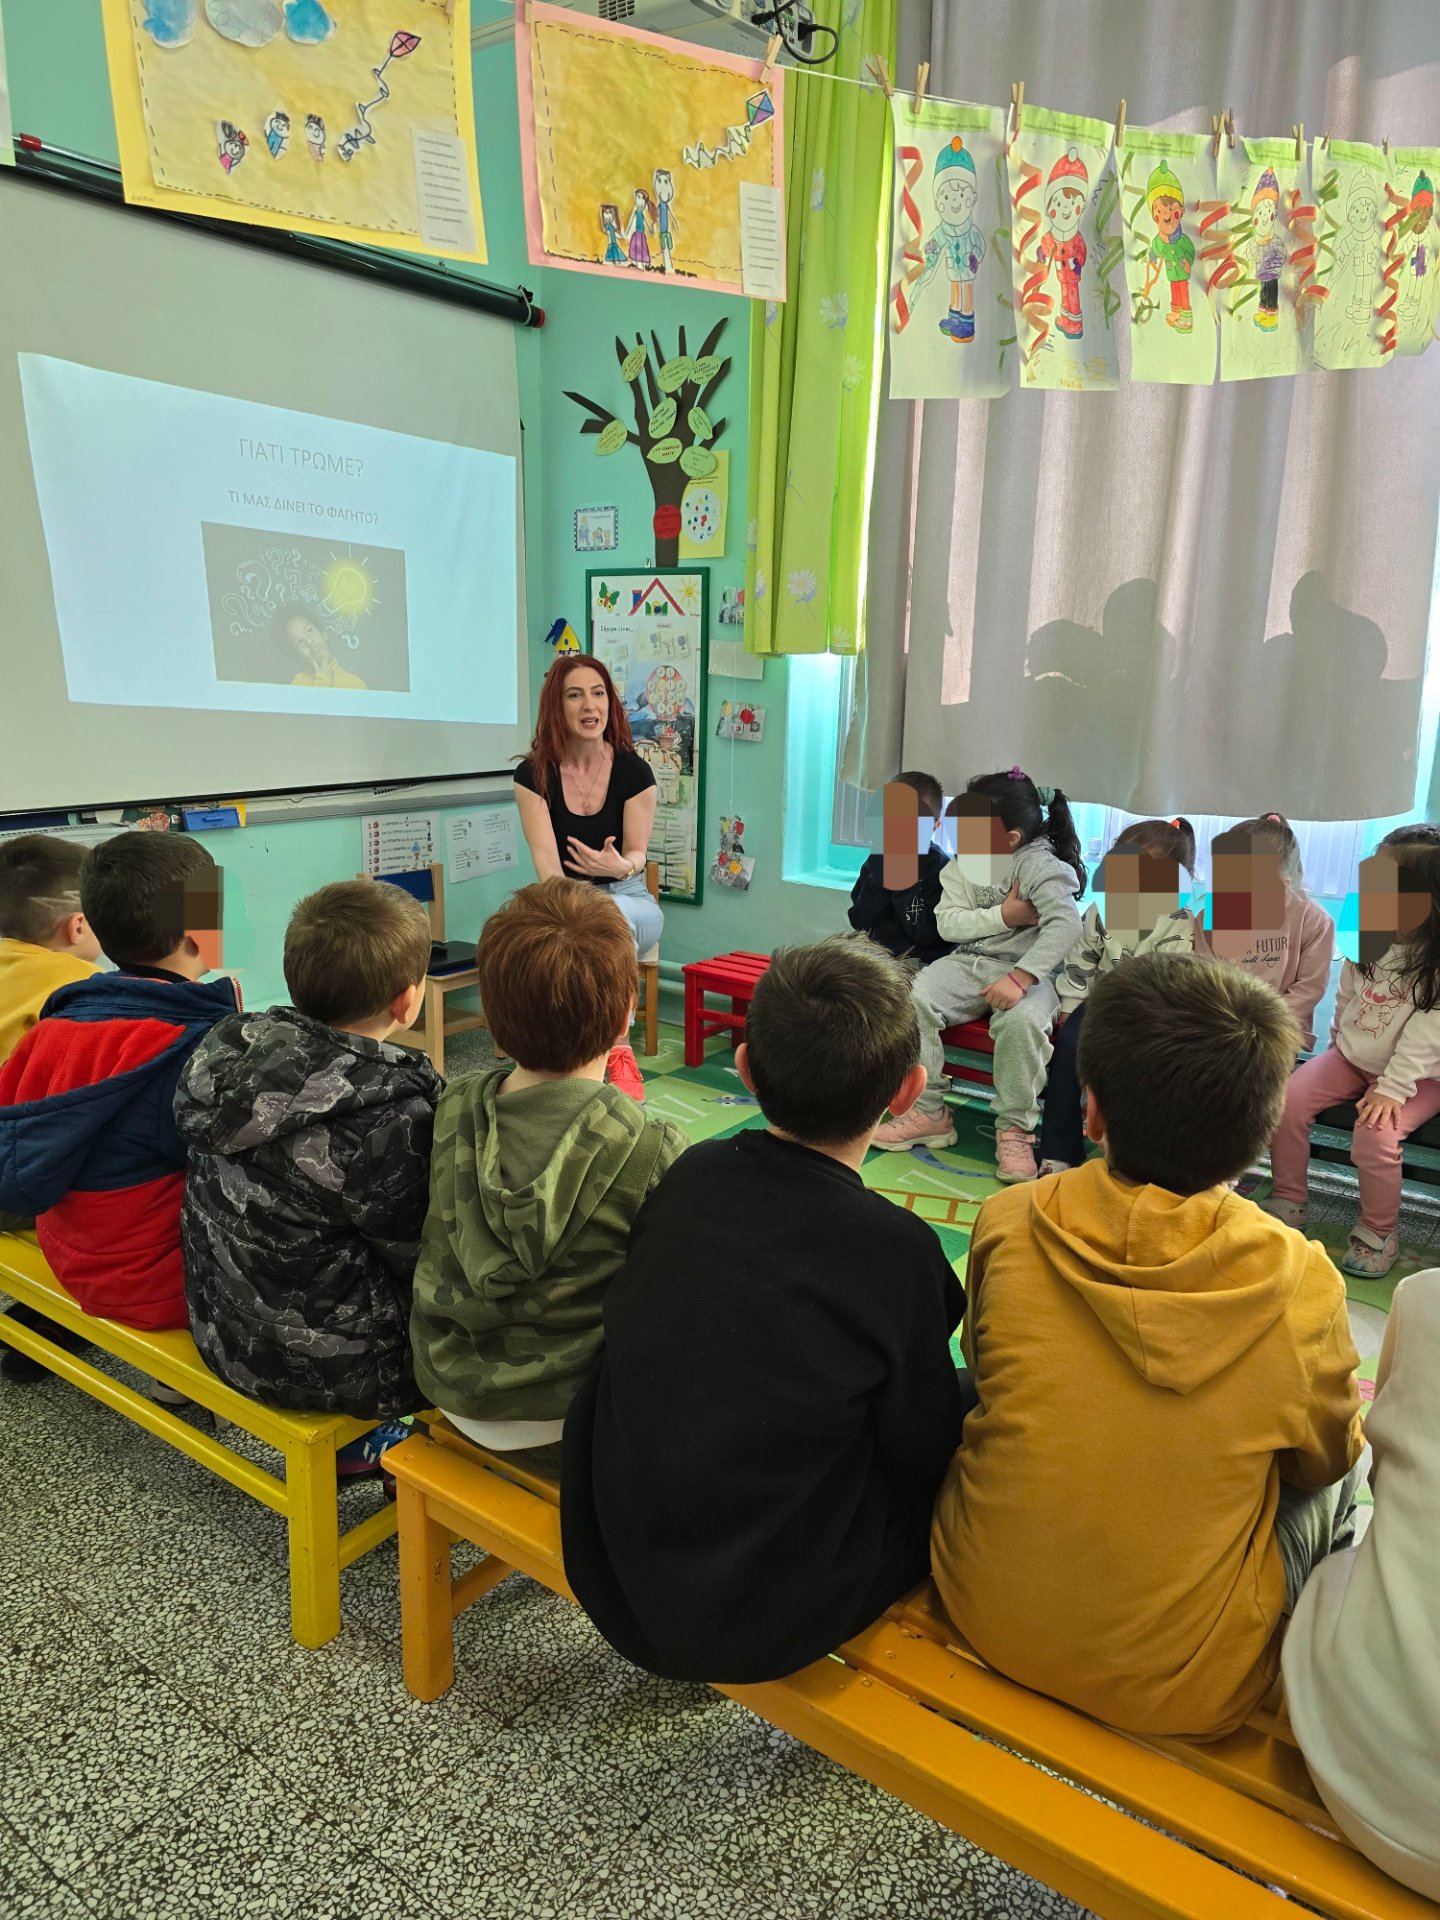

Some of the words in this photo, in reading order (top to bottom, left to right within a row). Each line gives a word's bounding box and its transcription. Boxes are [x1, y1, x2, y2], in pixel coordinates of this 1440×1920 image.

[239, 438, 284, 464] ΓΙΑΤΙ
[289, 447, 364, 477] ΤΡΩΜΕ?
[227, 490, 239, 504] ΤΙ
[243, 492, 271, 508] ΜΑΣ
[274, 497, 305, 513] ΔΙΝΕΙ
[308, 502, 324, 516] ΤΟ
[326, 506, 379, 525] ΦΑΓΗΤΟ?
[1256, 936, 1288, 953] FUTUR
